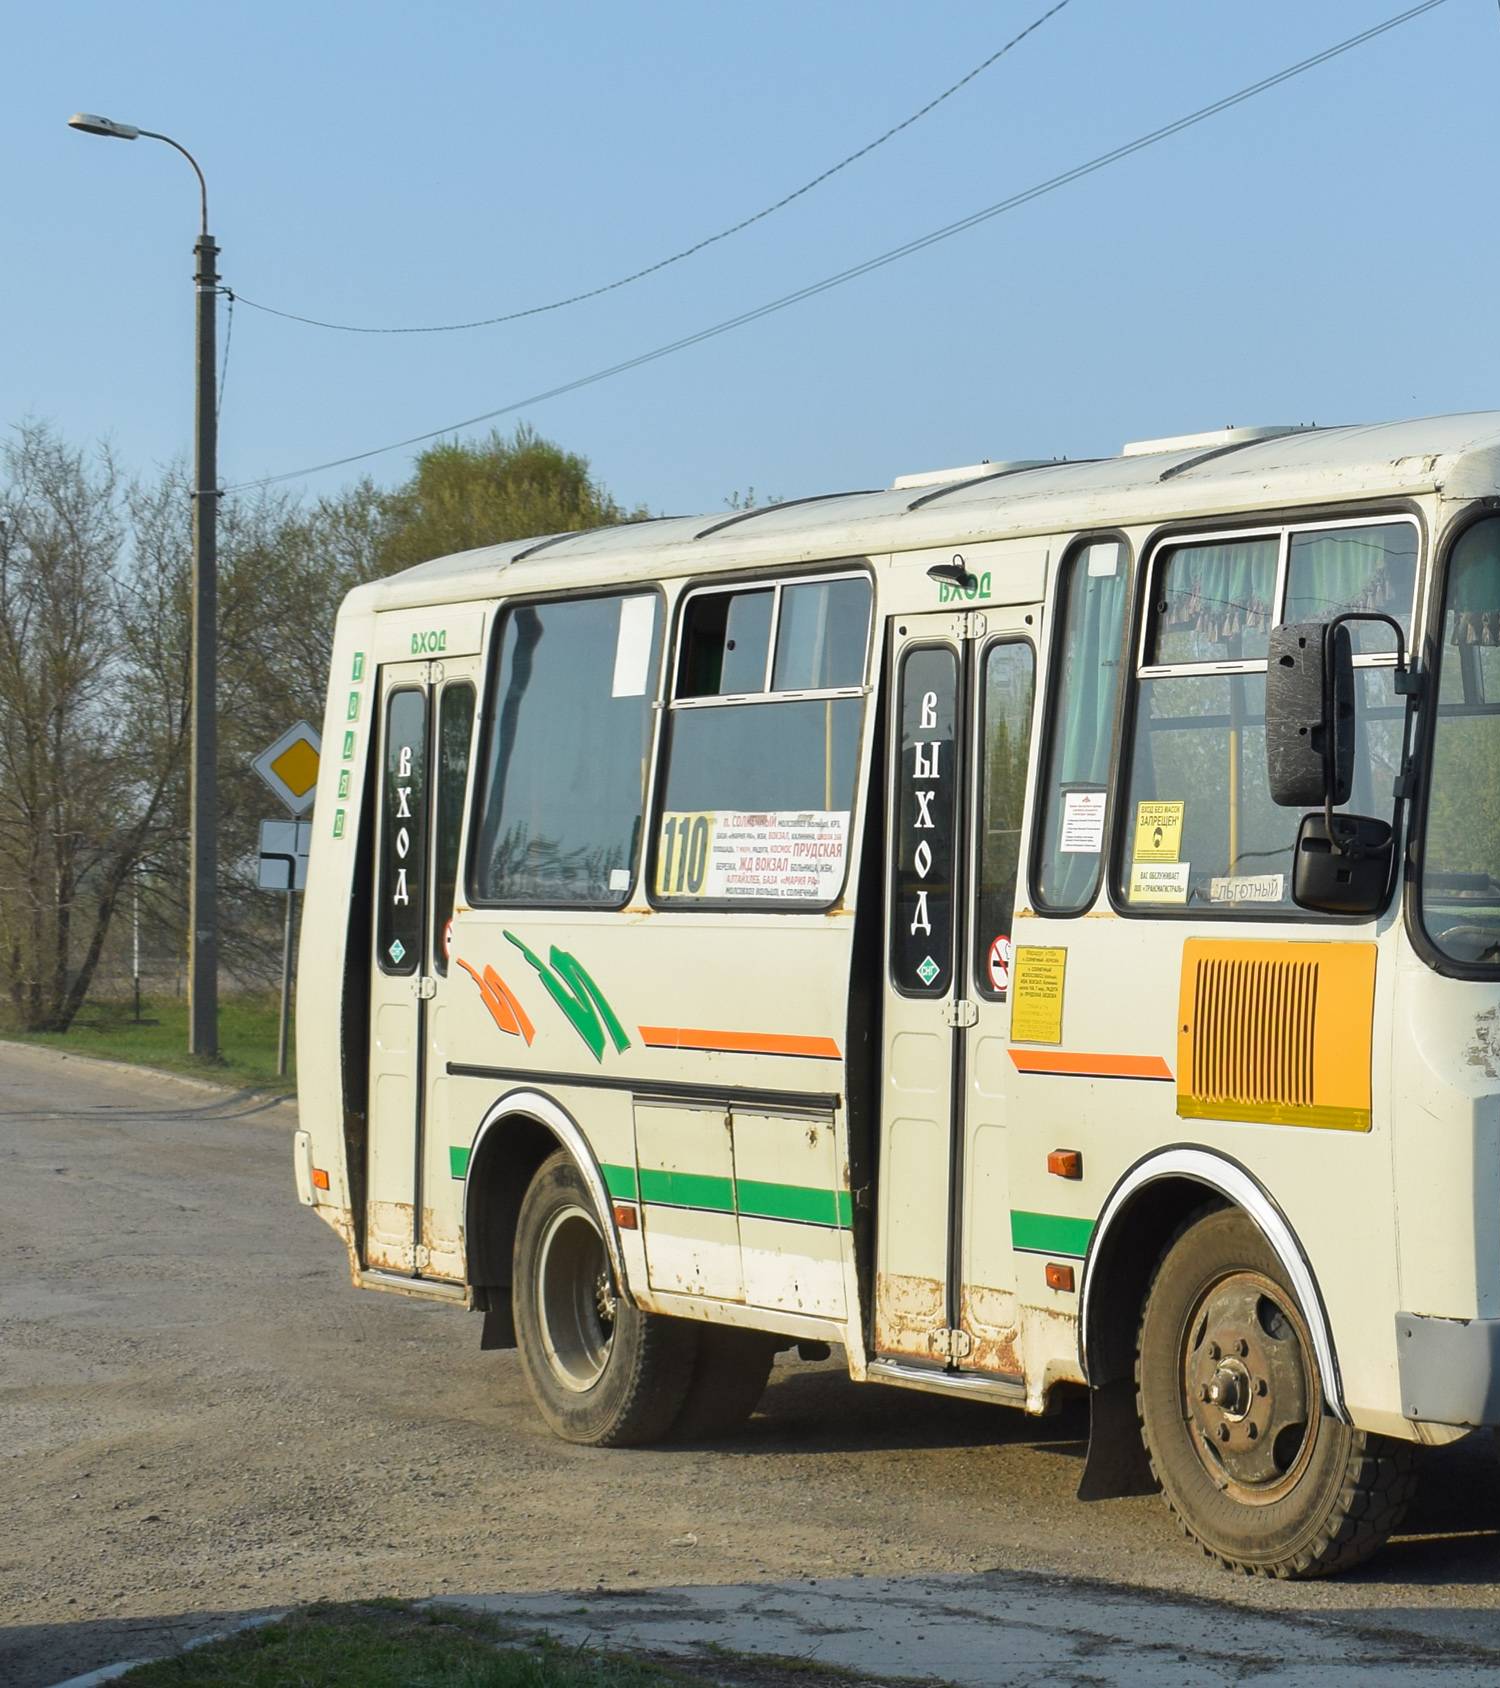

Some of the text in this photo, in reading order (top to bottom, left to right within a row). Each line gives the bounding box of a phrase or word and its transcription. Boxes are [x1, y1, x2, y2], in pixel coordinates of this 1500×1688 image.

[411, 630, 447, 654] ВХОД
[910, 691, 940, 937] ВЫХОД
[1141, 805, 1154, 814] ВХОД
[1154, 805, 1163, 813] БЕЗ
[393, 746, 412, 906] ВХОД
[663, 816, 709, 894] 110
[792, 843, 843, 860] ПРУДСКАЯ
[739, 857, 753, 873] ЖД
[755, 857, 789, 872] ВОКЗАЛ
